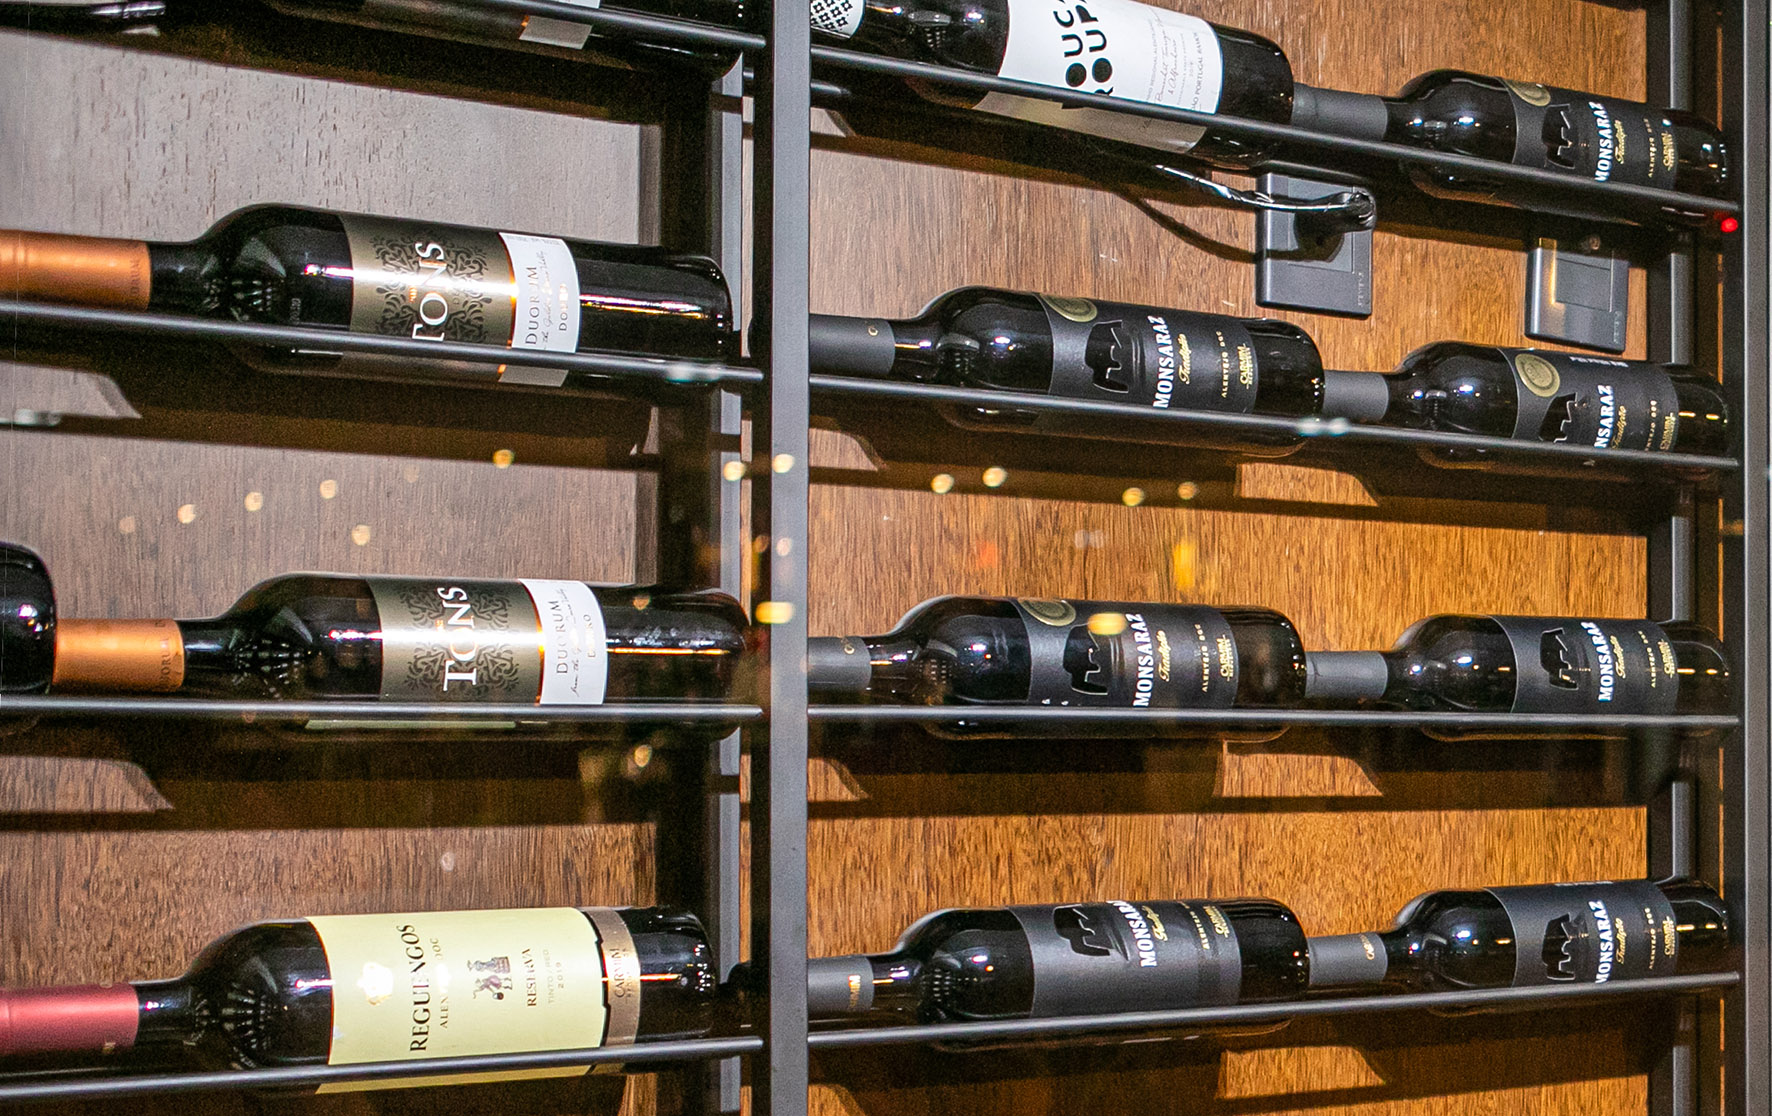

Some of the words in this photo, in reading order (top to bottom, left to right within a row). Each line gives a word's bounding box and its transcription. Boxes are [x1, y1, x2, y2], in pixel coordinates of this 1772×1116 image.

[1588, 101, 1613, 182] MONSARAZ
[411, 241, 449, 342] TONS
[1147, 315, 1174, 410] MONSARAZ
[1177, 333, 1192, 385] Tradição
[1215, 331, 1226, 347] DOC
[1220, 352, 1230, 398] ALENTEJO
[437, 587, 478, 692] TONS
[1125, 613, 1154, 707] MONSARAZ
[1156, 630, 1172, 682] Tradição
[1201, 645, 1210, 692] ALENTEJO
[1581, 622, 1614, 702] MONSARAZ
[1106, 900, 1158, 967] MONSARAZ
[1588, 900, 1614, 984] MONSARAZ
[1615, 917, 1627, 965] Tradição
[396, 924, 430, 1052] REGUENGOS
[523, 948, 537, 1008] RESERVA
